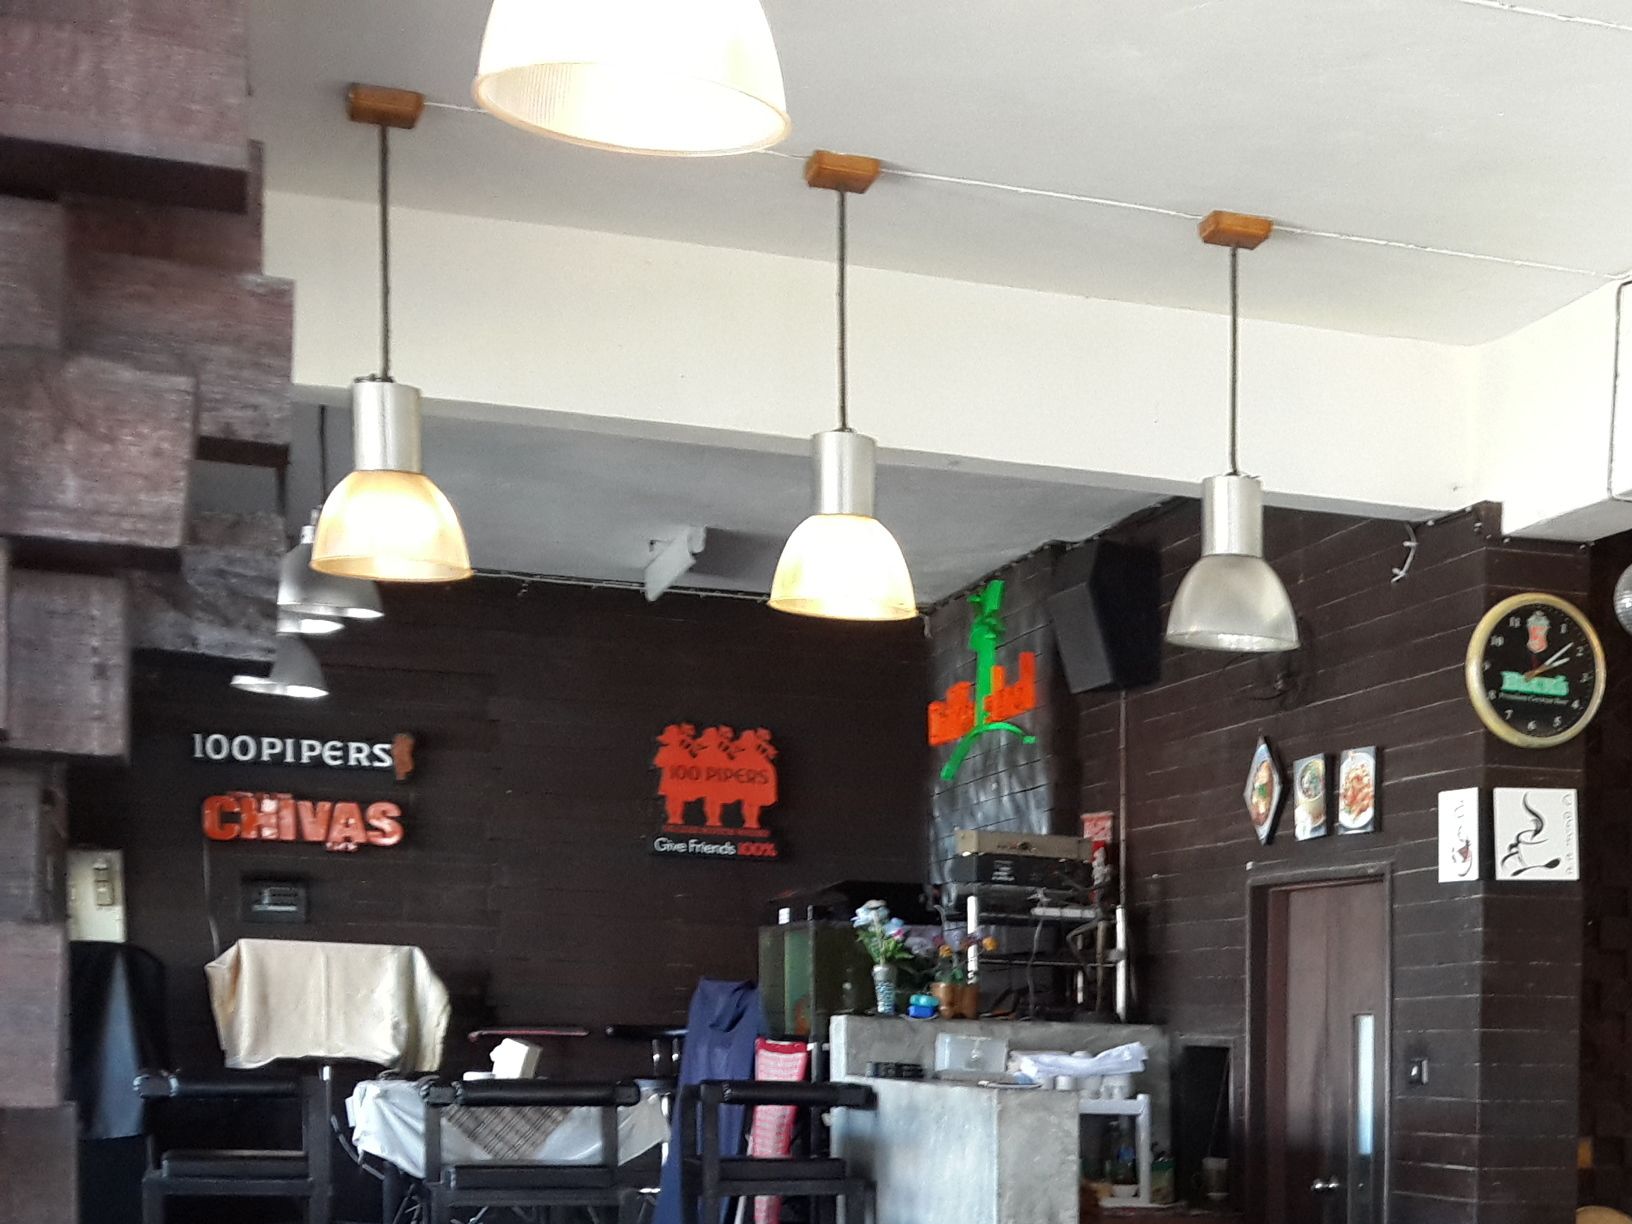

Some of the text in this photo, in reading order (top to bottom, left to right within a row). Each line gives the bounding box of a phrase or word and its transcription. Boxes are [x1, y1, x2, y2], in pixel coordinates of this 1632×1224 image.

[669, 764, 770, 784] 100 PIPERS
[203, 792, 404, 848] CHIVAS
[653, 837, 688, 853] Give
[688, 838, 737, 855] Friends
